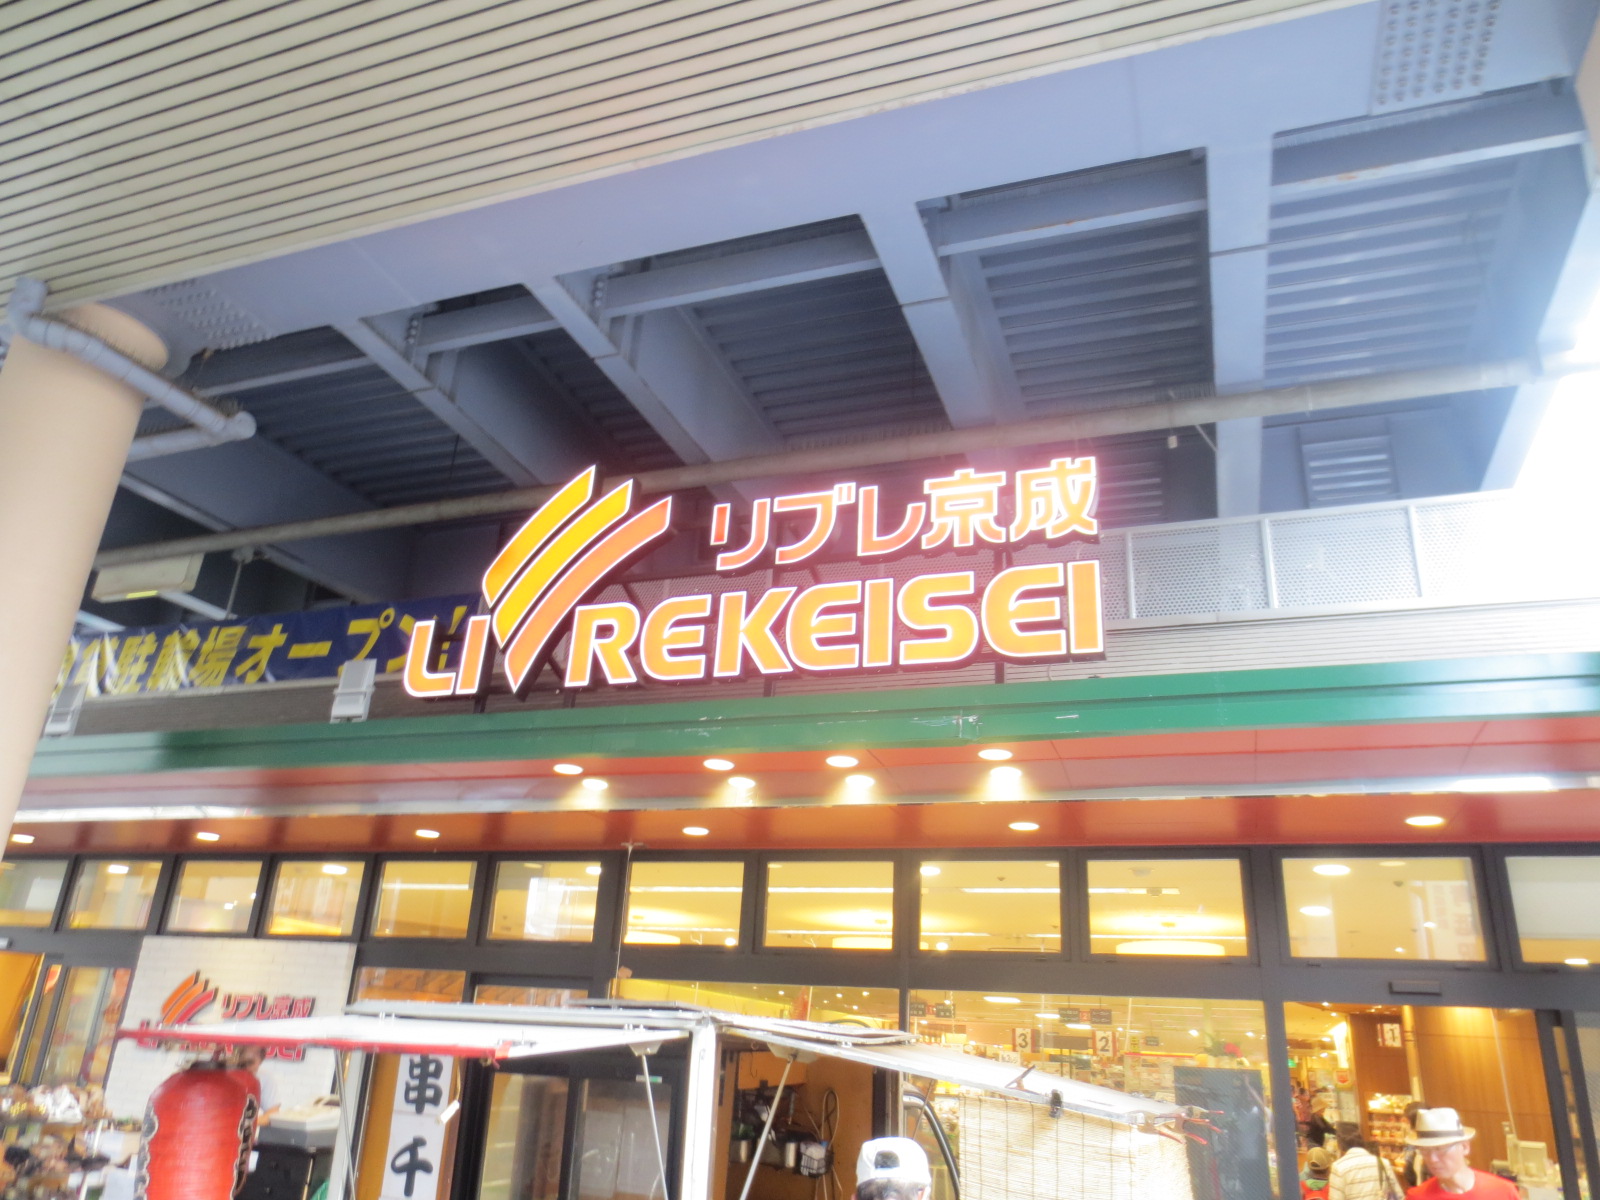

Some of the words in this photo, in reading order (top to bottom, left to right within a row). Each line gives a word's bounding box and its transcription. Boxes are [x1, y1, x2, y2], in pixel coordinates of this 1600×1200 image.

[711, 457, 1097, 571] リブレ京成
[222, 993, 313, 1020] リブレ京成
[1018, 1032, 1029, 1049] 3
[1098, 1036, 1110, 1052] 2
